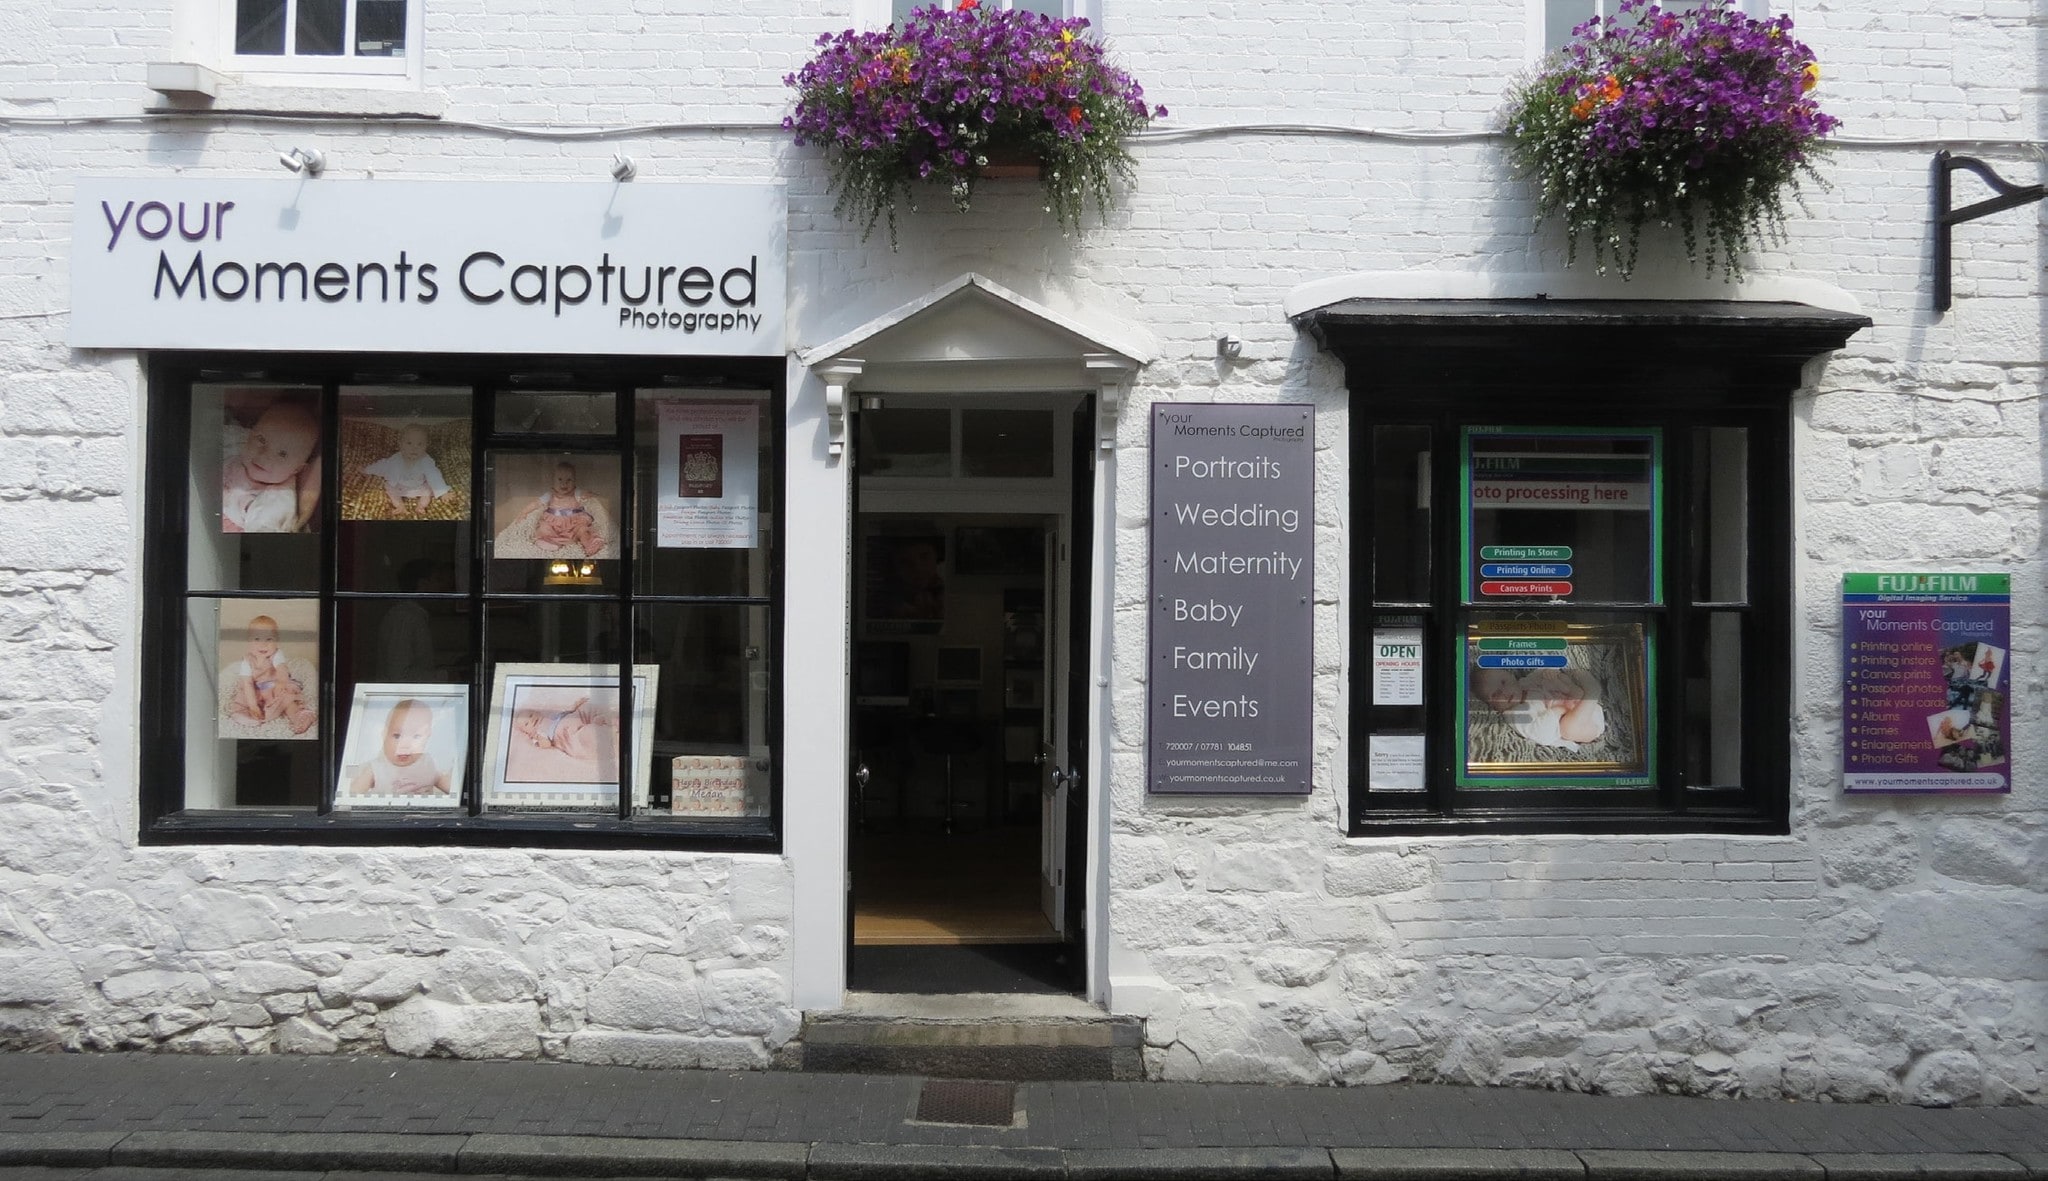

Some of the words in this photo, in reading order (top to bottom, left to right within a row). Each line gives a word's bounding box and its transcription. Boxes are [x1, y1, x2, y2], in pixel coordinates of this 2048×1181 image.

[101, 199, 235, 252] your
[153, 249, 439, 302] Moments
[459, 251, 757, 317] Captured
[619, 308, 762, 334] Photography
[1164, 413, 1193, 426] your
[1174, 425, 1236, 437] Moments
[1239, 425, 1304, 439] Captured
[1176, 455, 1281, 479] Portraits
[1506, 485, 1590, 503] processing
[1594, 484, 1628, 500] here
[1174, 503, 1299, 533] Wedding
[1494, 548, 1526, 558] Printing
[1528, 548, 1536, 556] In
[1538, 548, 1558, 556] Store
[1174, 551, 1303, 580] Maternity
[1496, 566, 1528, 576] Printing
[1530, 566, 1556, 574] Online
[1500, 584, 1528, 592] Canvas
[1530, 584, 1553, 592] Prints
[1877, 575, 1977, 592] FUJIFILM
[1878, 594, 1903, 602] Digital
[1905, 594, 1937, 603] Imaging
[1174, 598, 1244, 627] Baby
[1859, 609, 1887, 621] your
[1866, 619, 1928, 631] Moments
[1931, 619, 1994, 634] Captured
[1508, 640, 1537, 648] Frames
[1860, 642, 1899, 653] Printing
[1902, 643, 1933, 651] online
[1380, 645, 1416, 658] OPEN
[1173, 646, 1259, 676] Family
[1501, 658, 1524, 666] Photo
[1526, 658, 1545, 666] Gifts
[1860, 656, 1899, 667] Printing
[1901, 656, 1936, 665] instore
[1861, 670, 1901, 679] Canvas
[1904, 670, 1932, 681] prints
[1861, 684, 1905, 695] Passport
[1907, 684, 1943, 695] photos
[1173, 694, 1259, 718] Events
[1861, 698, 1892, 707] Thank
[1894, 700, 1915, 709] you
[1917, 698, 1946, 707] cards
[1861, 712, 1900, 721] Albums
[1861, 726, 1899, 735] Frames
[1166, 743, 1193, 751] 720007
[1201, 743, 1223, 751] 07781
[1861, 740, 1932, 751] Enlargements
[1861, 754, 1892, 764] Photo
[1895, 754, 1919, 764] Gifts
[1169, 775, 1286, 783] yourmomentscaptured.co.uk
